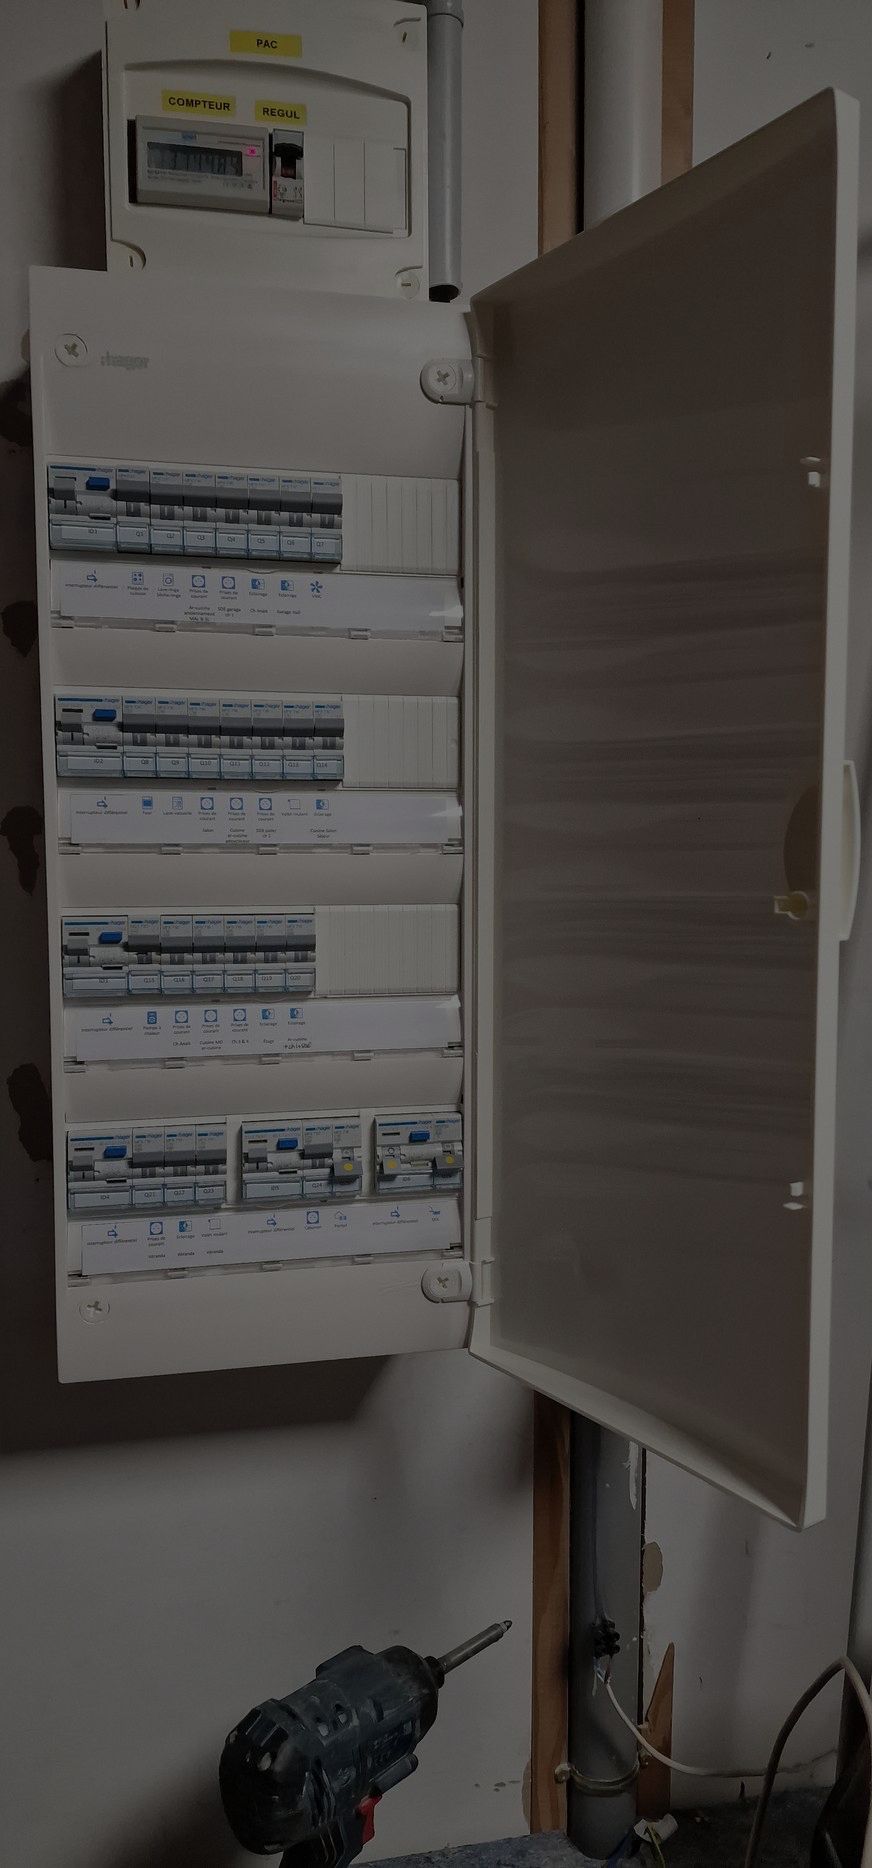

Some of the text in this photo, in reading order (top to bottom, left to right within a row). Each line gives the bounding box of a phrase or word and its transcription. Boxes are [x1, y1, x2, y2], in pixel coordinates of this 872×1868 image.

[256, 38, 278, 49] PAC
[168, 96, 230, 111] COMPTEUR
[262, 107, 300, 120] REGUL
